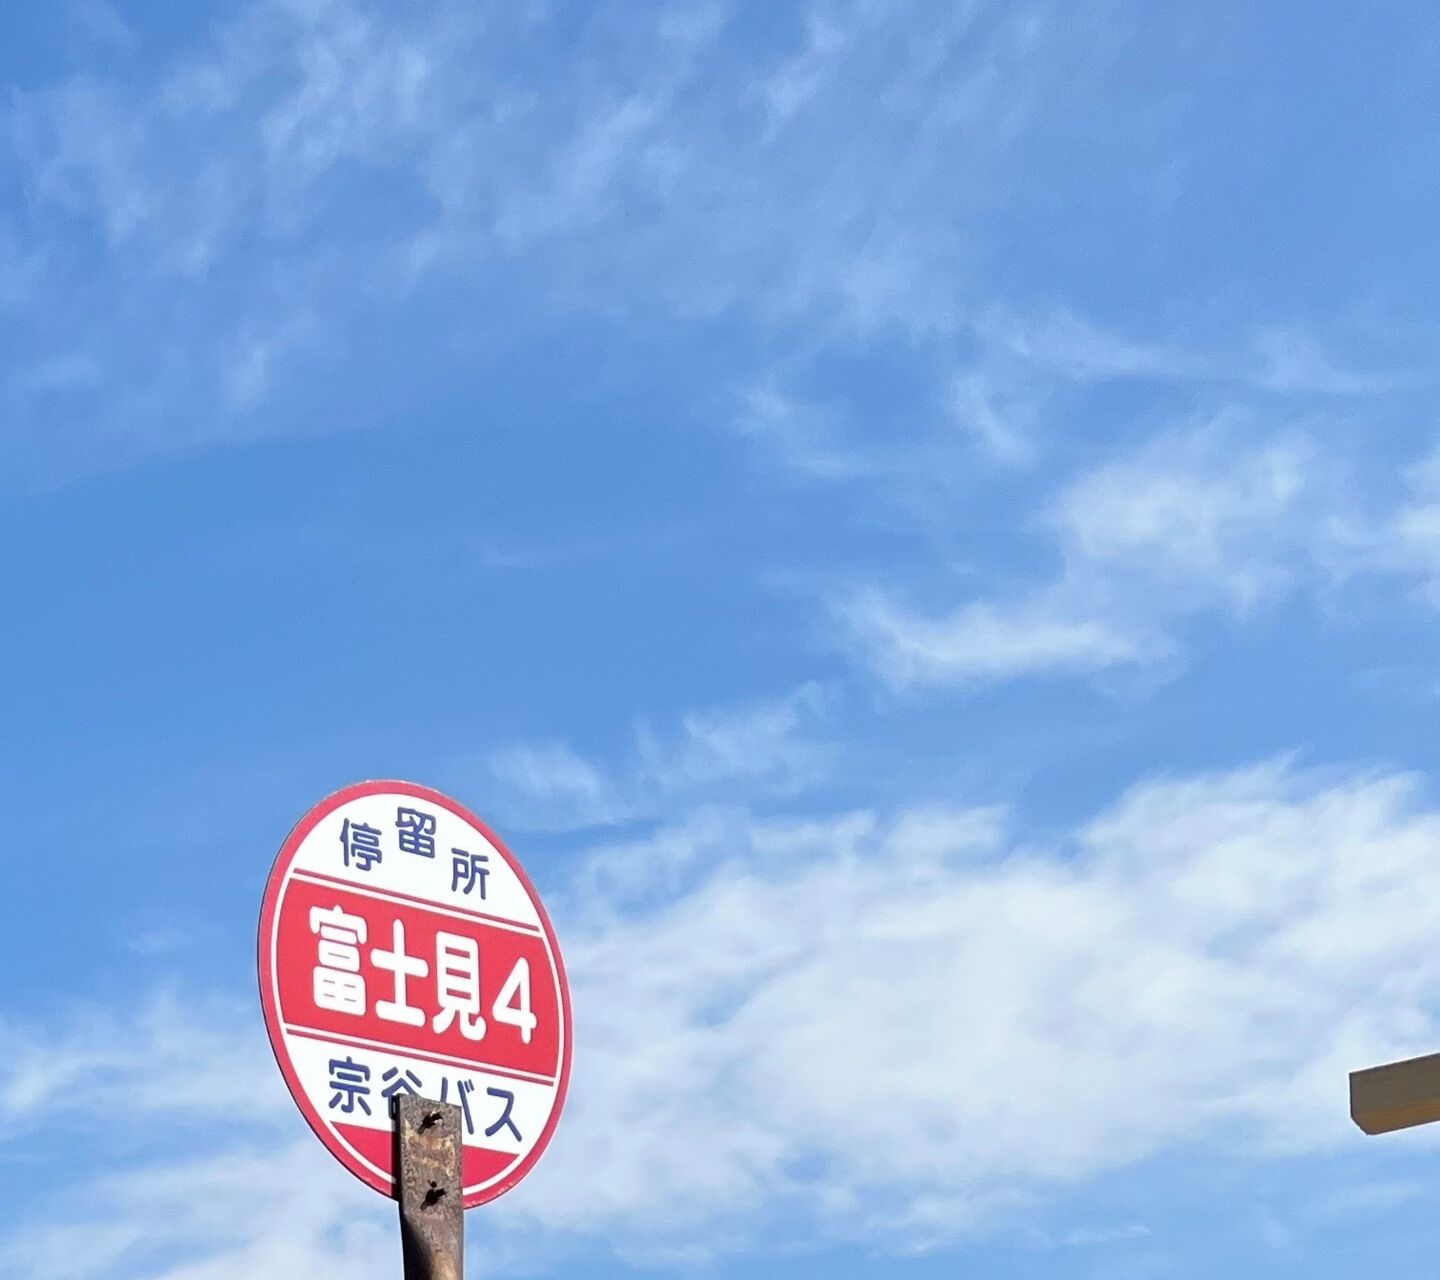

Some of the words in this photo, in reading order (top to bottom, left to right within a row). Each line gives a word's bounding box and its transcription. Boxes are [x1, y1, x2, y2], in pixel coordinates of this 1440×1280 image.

[339, 807, 490, 900] 停留所
[309, 904, 537, 1044] 富士見4
